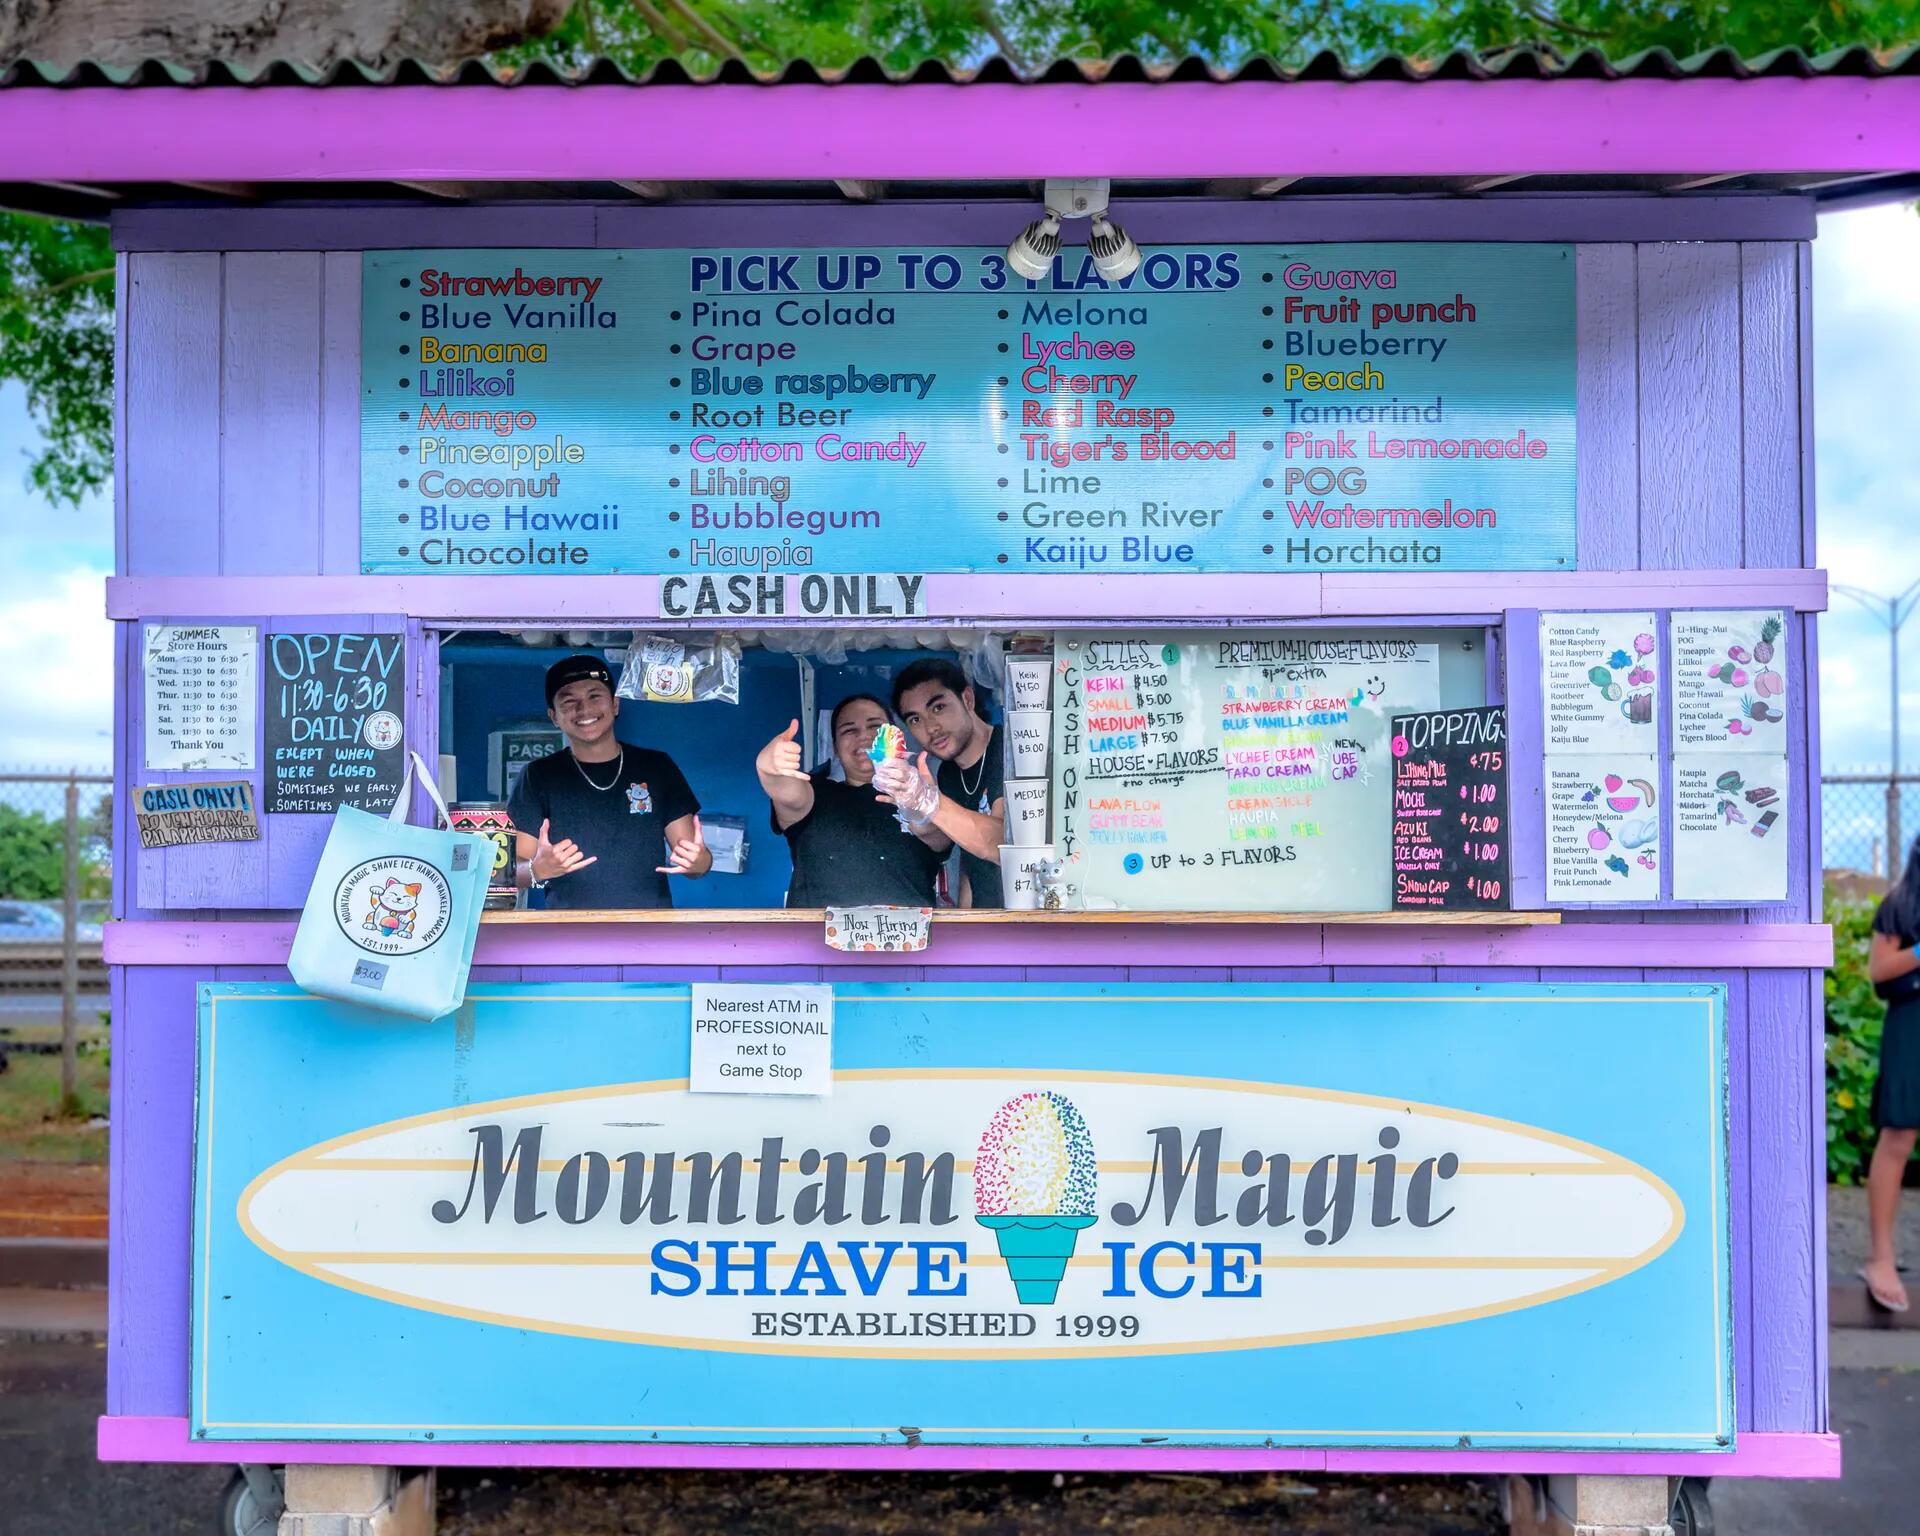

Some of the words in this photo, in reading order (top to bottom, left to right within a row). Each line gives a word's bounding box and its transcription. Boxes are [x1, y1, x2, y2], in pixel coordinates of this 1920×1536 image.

[420, 269, 603, 302] Strawberry
[690, 254, 801, 293] PICK
[816, 254, 882, 291] UP
[899, 253, 963, 291] TO
[980, 254, 1007, 291] 3
[1283, 264, 1397, 291] Guava
[421, 304, 491, 330] Blue
[503, 303, 617, 330] Vanilla
[692, 302, 762, 328] Pina
[775, 300, 896, 327] Colada
[1022, 300, 1147, 327] Melona
[1284, 295, 1360, 324] Fruit
[1372, 295, 1476, 328] punch
[420, 336, 547, 364] Banana
[691, 335, 797, 367] Grape
[1022, 333, 1136, 367] Lychee
[1285, 330, 1447, 363] Blueberry
[420, 369, 515, 397] Lilikoi
[691, 368, 763, 396] Blue
[775, 365, 936, 400] raspberry
[1021, 366, 1138, 399] Cherry
[1285, 362, 1384, 391] Peach
[418, 403, 537, 436] Mango
[693, 403, 765, 428] Root
[778, 402, 852, 427] Beer
[1022, 401, 1083, 428] Red
[1096, 401, 1175, 433] Rasp
[1284, 397, 1443, 424] Tamarind
[419, 436, 584, 470] Pineapple
[690, 436, 803, 463] Cotton
[815, 432, 926, 467] Candy
[1020, 433, 1128, 467] Tiger's
[1141, 432, 1236, 462] Blood
[1285, 431, 1357, 459] Pink
[1368, 430, 1548, 460] Lemonade
[418, 471, 560, 498] Coconut
[690, 468, 790, 502] Lihing
[1023, 468, 1101, 495] Lime
[1285, 467, 1367, 496] POG
[420, 505, 490, 531] Blue
[504, 504, 619, 531] Hawaii
[691, 501, 881, 536] Bubblegum
[1022, 502, 1131, 529] Green
[1142, 501, 1223, 528] River
[1286, 500, 1497, 530] Watermelon
[419, 539, 589, 566] Chocolate
[691, 538, 813, 572] Haupia
[1025, 536, 1112, 570] Kaiju
[1123, 536, 1194, 563] Blue
[1286, 537, 1442, 564] Horchata
[662, 575, 786, 617] CASH
[801, 574, 924, 616] ONLY
[168, 641, 194, 651] Store
[197, 641, 228, 651] Hours
[172, 629, 220, 641] SUMMER
[271, 634, 400, 681] OPEN
[1084, 639, 1151, 664] SIZES
[1086, 678, 1125, 692] KEIKI
[1133, 674, 1168, 690] $4.50
[1679, 680, 1705, 689] Mango
[1087, 699, 1133, 712] SMALL
[1137, 693, 1172, 709] $5.00
[1222, 700, 1303, 717] STRAWBERRY
[1305, 699, 1347, 712] CREAM
[291, 714, 364, 744] DAILY
[1088, 715, 1147, 732] MEDIUM
[1222, 717, 1251, 731] BLUE
[1254, 716, 1304, 729] VANILLA
[1306, 713, 1348, 726] CREAM
[1679, 723, 1706, 732] Lychee
[171, 740, 202, 750] Thank
[205, 740, 224, 750] You
[1089, 735, 1137, 752] LARGE
[1141, 731, 1178, 747] $7.50
[1551, 736, 1571, 744] Kaiju
[1680, 734, 1703, 743] Tigers
[1705, 734, 1727, 742] Blood
[275, 747, 323, 761] EXCEPT
[335, 747, 375, 761] WHEN
[1156, 748, 1218, 770] FLAVORS
[1225, 750, 1271, 765] LYCHEE
[1275, 748, 1315, 762] CREAM
[1332, 752, 1358, 765] UBE
[277, 765, 315, 779] WE'RE
[328, 764, 376, 778] CLOSED
[1226, 766, 1261, 779] TARO
[1266, 764, 1312, 777] CREAM
[1332, 766, 1358, 781] CAP
[1679, 769, 1706, 778] Haupia
[1679, 780, 1708, 788] Matcha
[277, 781, 335, 795] SOMETIMES
[345, 784, 360, 793] WE
[1552, 781, 1594, 790] Strawberry
[143, 788, 190, 811] CASH
[276, 799, 332, 812] SOMETIMES
[1395, 790, 1425, 808] MOCHI
[1552, 803, 1599, 811] Watermelon
[1394, 821, 1428, 836] AZUKI
[1553, 824, 1575, 832] Peach
[1680, 812, 1717, 821] Tamarind
[1680, 823, 1717, 831] Chocolate
[400, 859, 414, 871] ICE
[1151, 855, 1172, 869] UP
[1203, 853, 1215, 865] 3
[1222, 846, 1296, 866] FLAVORS
[1394, 846, 1410, 860] ICE
[1412, 846, 1443, 860] CREAM
[348, 868, 370, 887] MAGIC
[372, 859, 399, 873] SHAVE
[416, 863, 441, 885] HAWAII
[1428, 879, 1450, 893] CAP
[1553, 878, 1571, 887] Pink
[1572, 878, 1612, 886] Lemonade
[340, 885, 352, 924] MOUNTAIN
[436, 882, 448, 915] WAIKELE
[421, 916, 446, 943] MAKAHA
[706, 998, 764, 1013] Nearest
[767, 999, 801, 1013] ATM
[806, 1000, 819, 1013] in
[696, 1020, 829, 1035] PROFESSIONAIL
[737, 1044, 768, 1056] next
[772, 1044, 786, 1056] to
[719, 1063, 764, 1078] Game
[769, 1064, 803, 1081] Stop
[431, 1124, 959, 1226] Mountain
[1110, 1126, 1460, 1247] Magic
[651, 1239, 968, 1297] SHAVE
[1102, 1240, 1263, 1299] ICE
[752, 1312, 1037, 1338] ESTABLISHED
[1055, 1315, 1141, 1338] 1999
